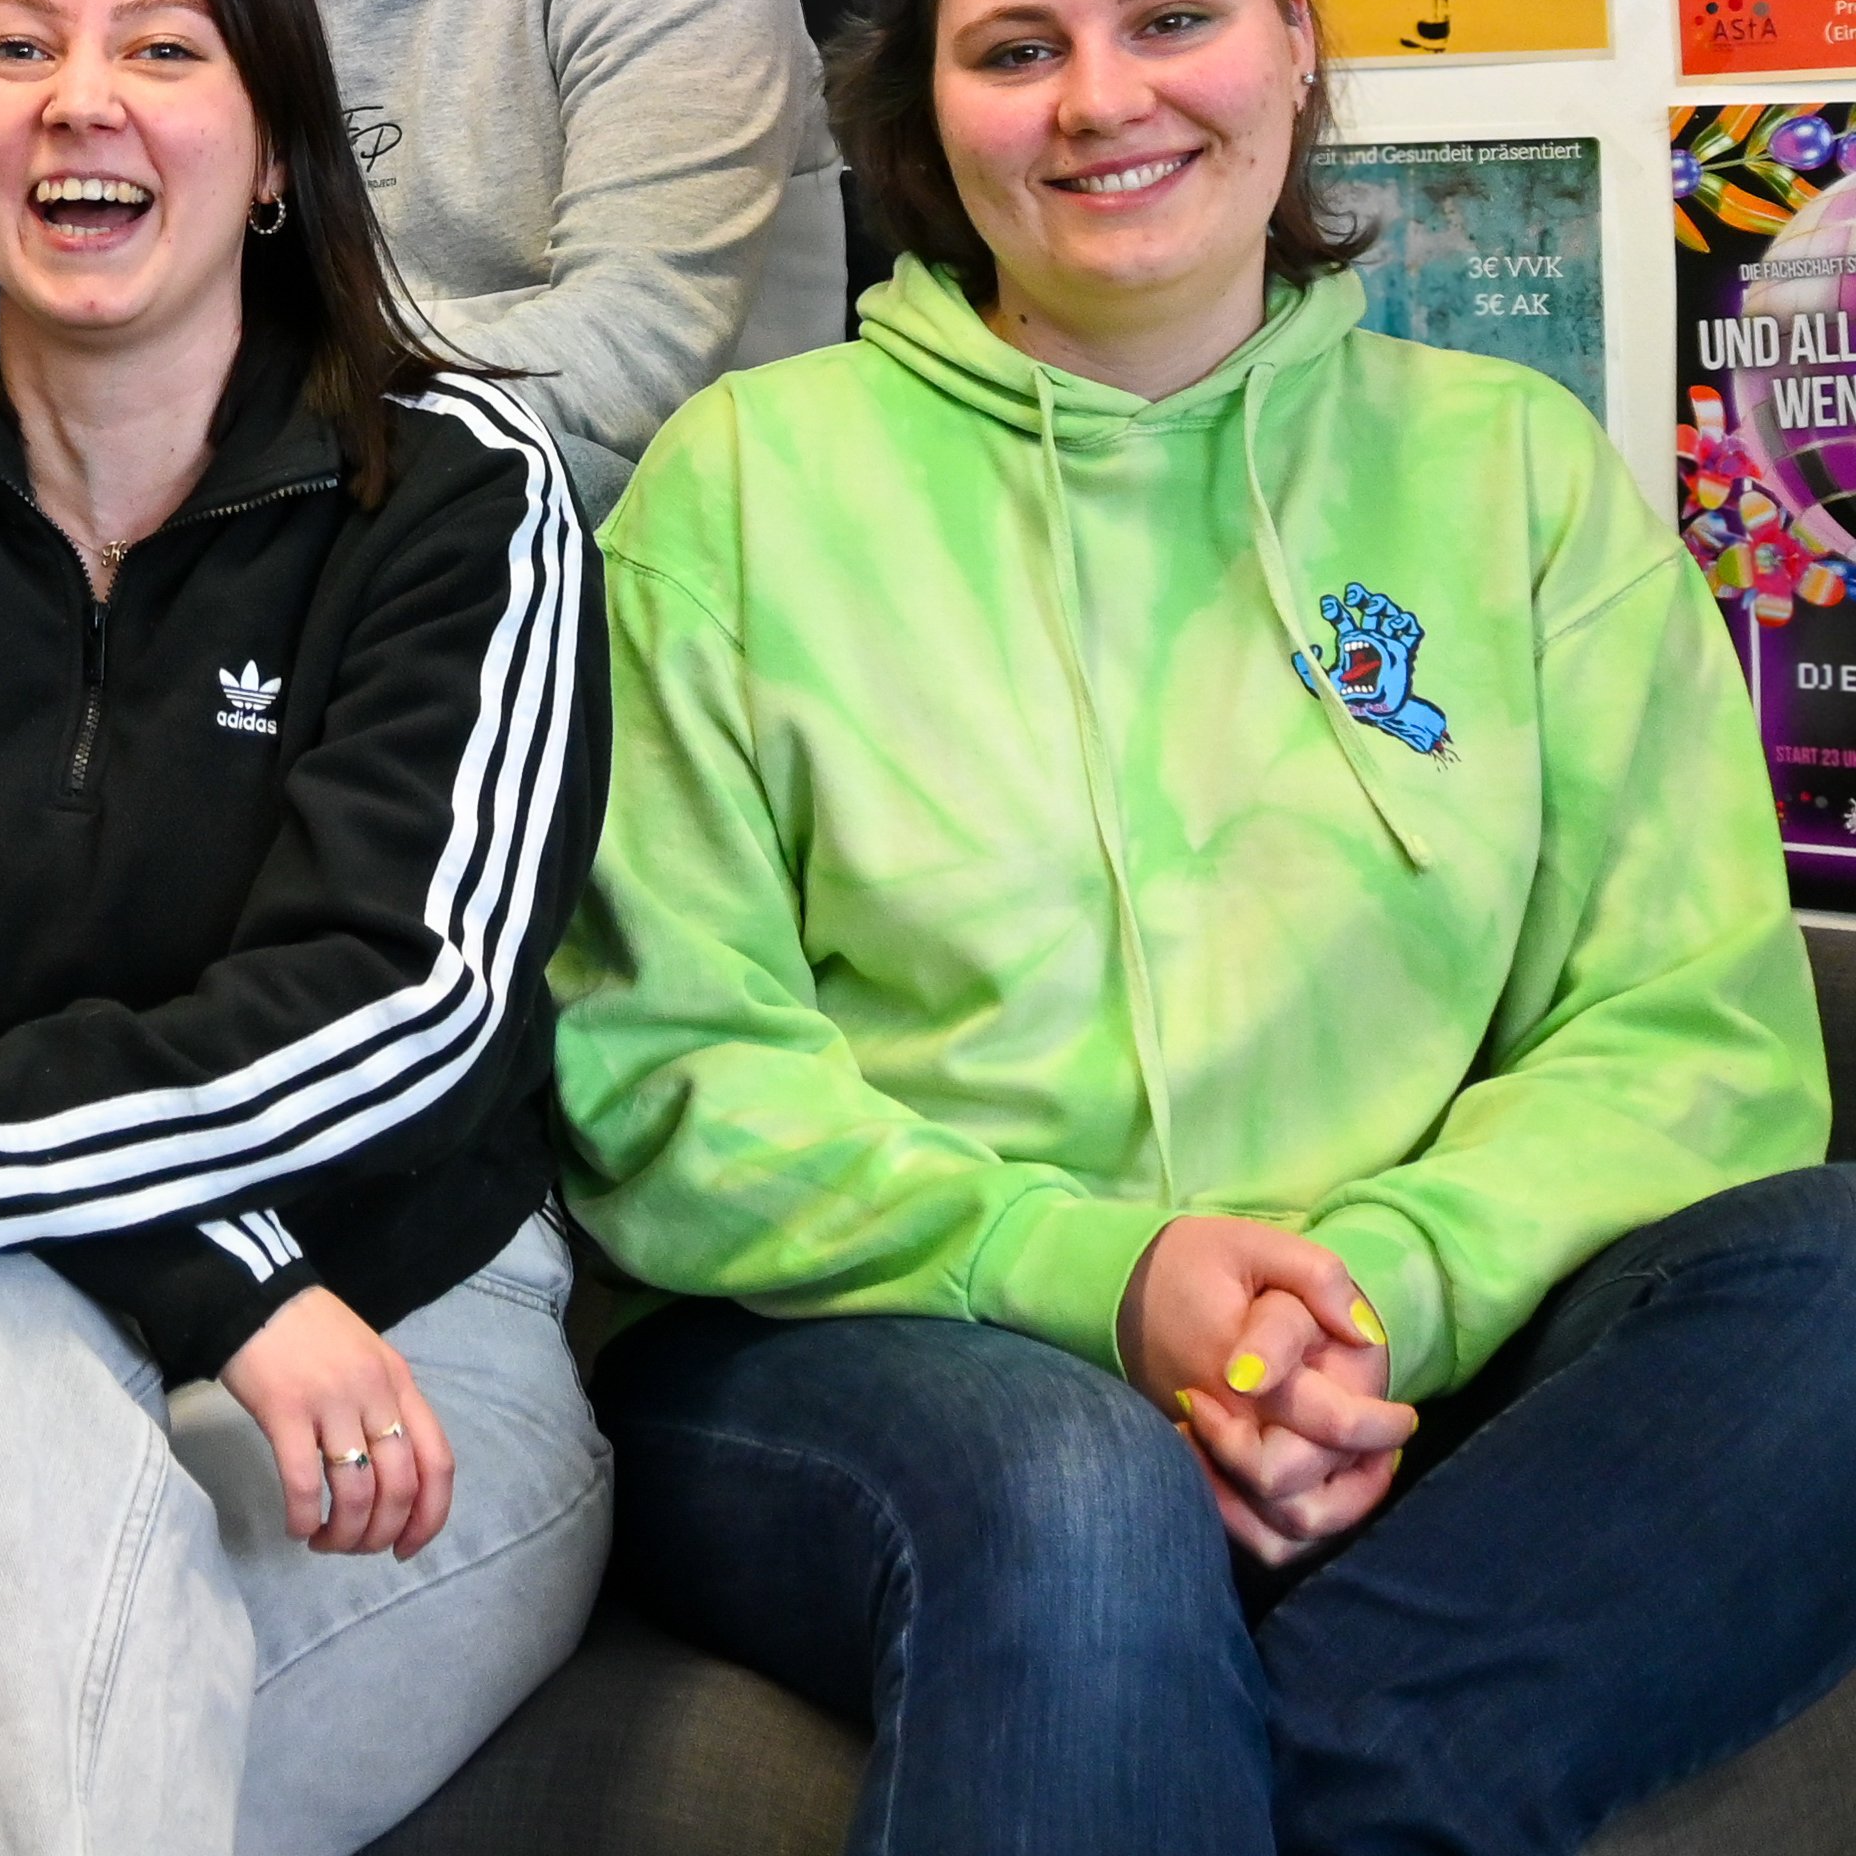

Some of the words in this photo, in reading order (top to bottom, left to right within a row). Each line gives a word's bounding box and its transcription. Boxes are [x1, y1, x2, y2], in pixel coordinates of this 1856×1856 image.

[1713, 17, 1778, 41] AStA
[1343, 145, 1378, 166] und
[1381, 142, 1474, 166] Gesundeit
[1477, 141, 1583, 166] präsentiert
[1467, 256, 1500, 280] 3€
[1503, 255, 1565, 280] VVK
[1739, 262, 1762, 282] DIE
[1762, 256, 1845, 280] FACHSCHAFT
[1474, 293, 1506, 318] 5€
[1510, 293, 1552, 317] AK
[1698, 315, 1781, 372] UND
[1797, 661, 1834, 691] DJ
[216, 709, 278, 735] adidas
[1775, 744, 1820, 766] START
[1820, 747, 1841, 767] 23
